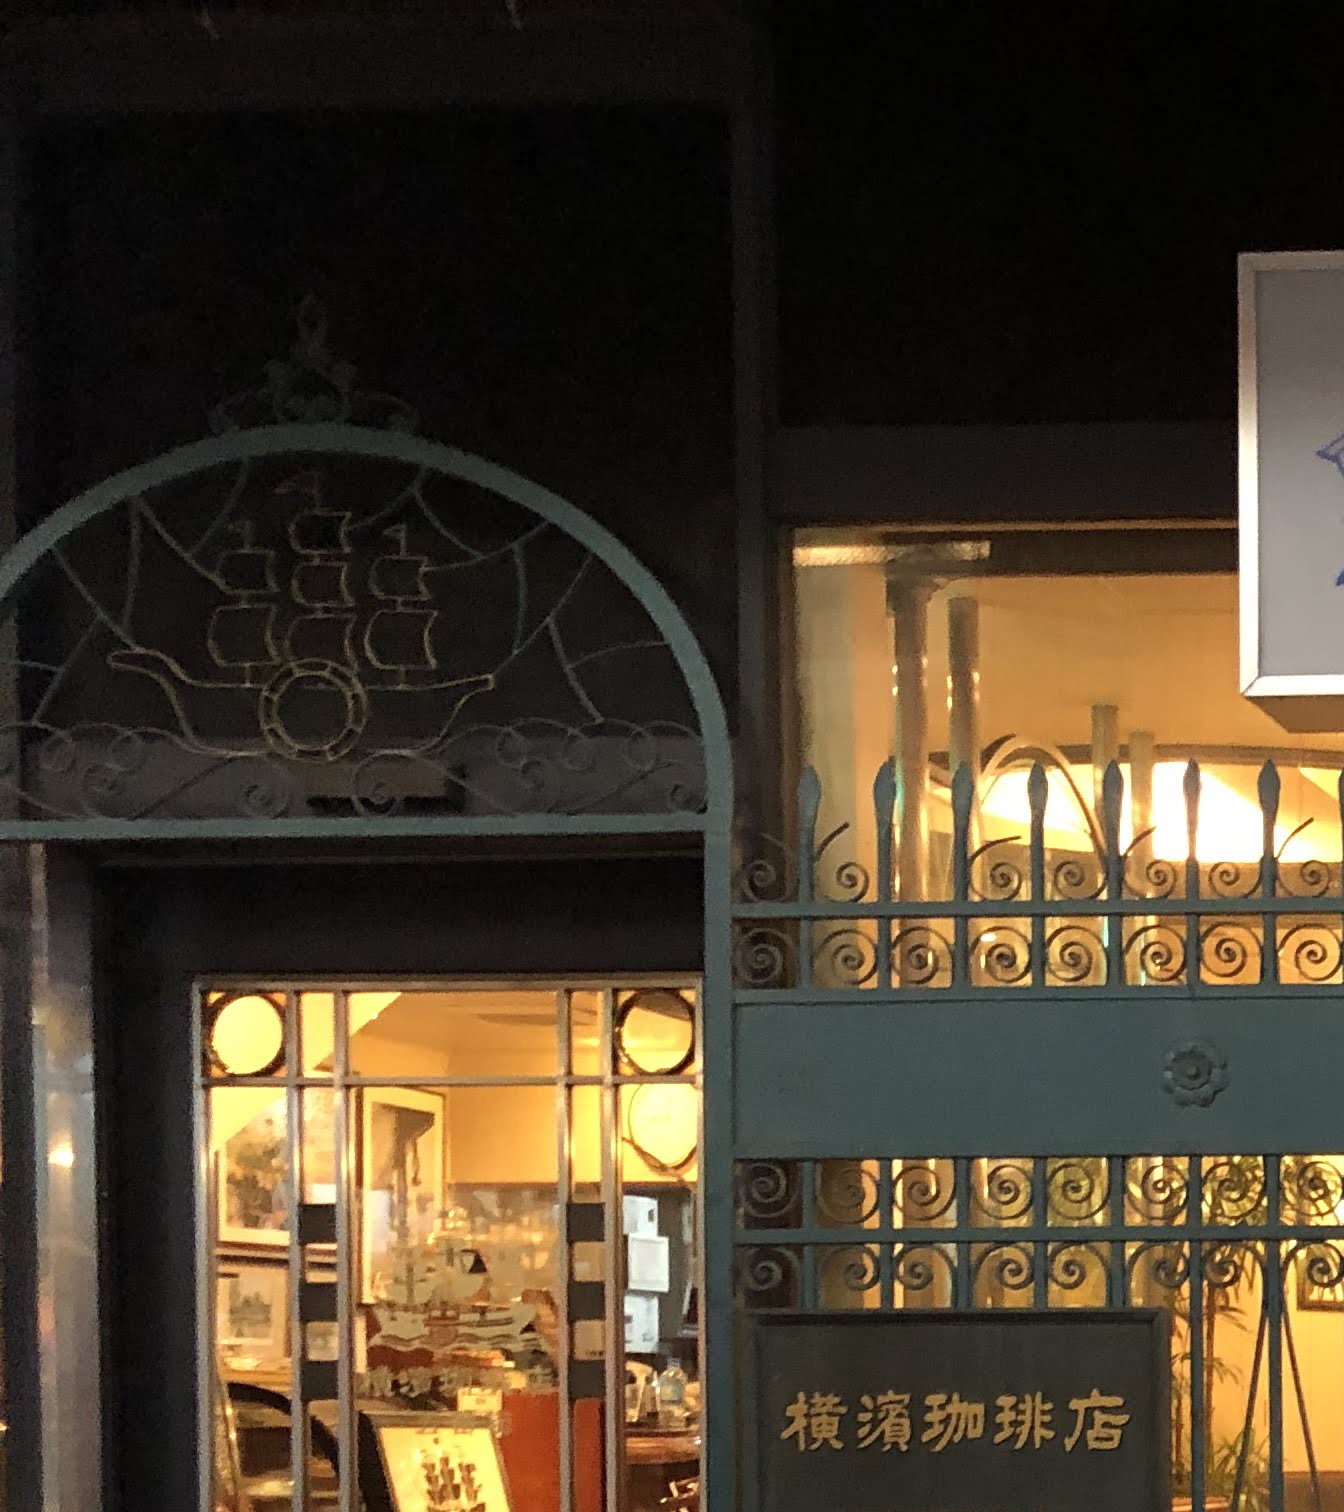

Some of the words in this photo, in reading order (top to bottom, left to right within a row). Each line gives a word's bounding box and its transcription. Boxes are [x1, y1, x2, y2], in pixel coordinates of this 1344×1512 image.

[780, 1388, 1131, 1453] 横濱珈琲店
